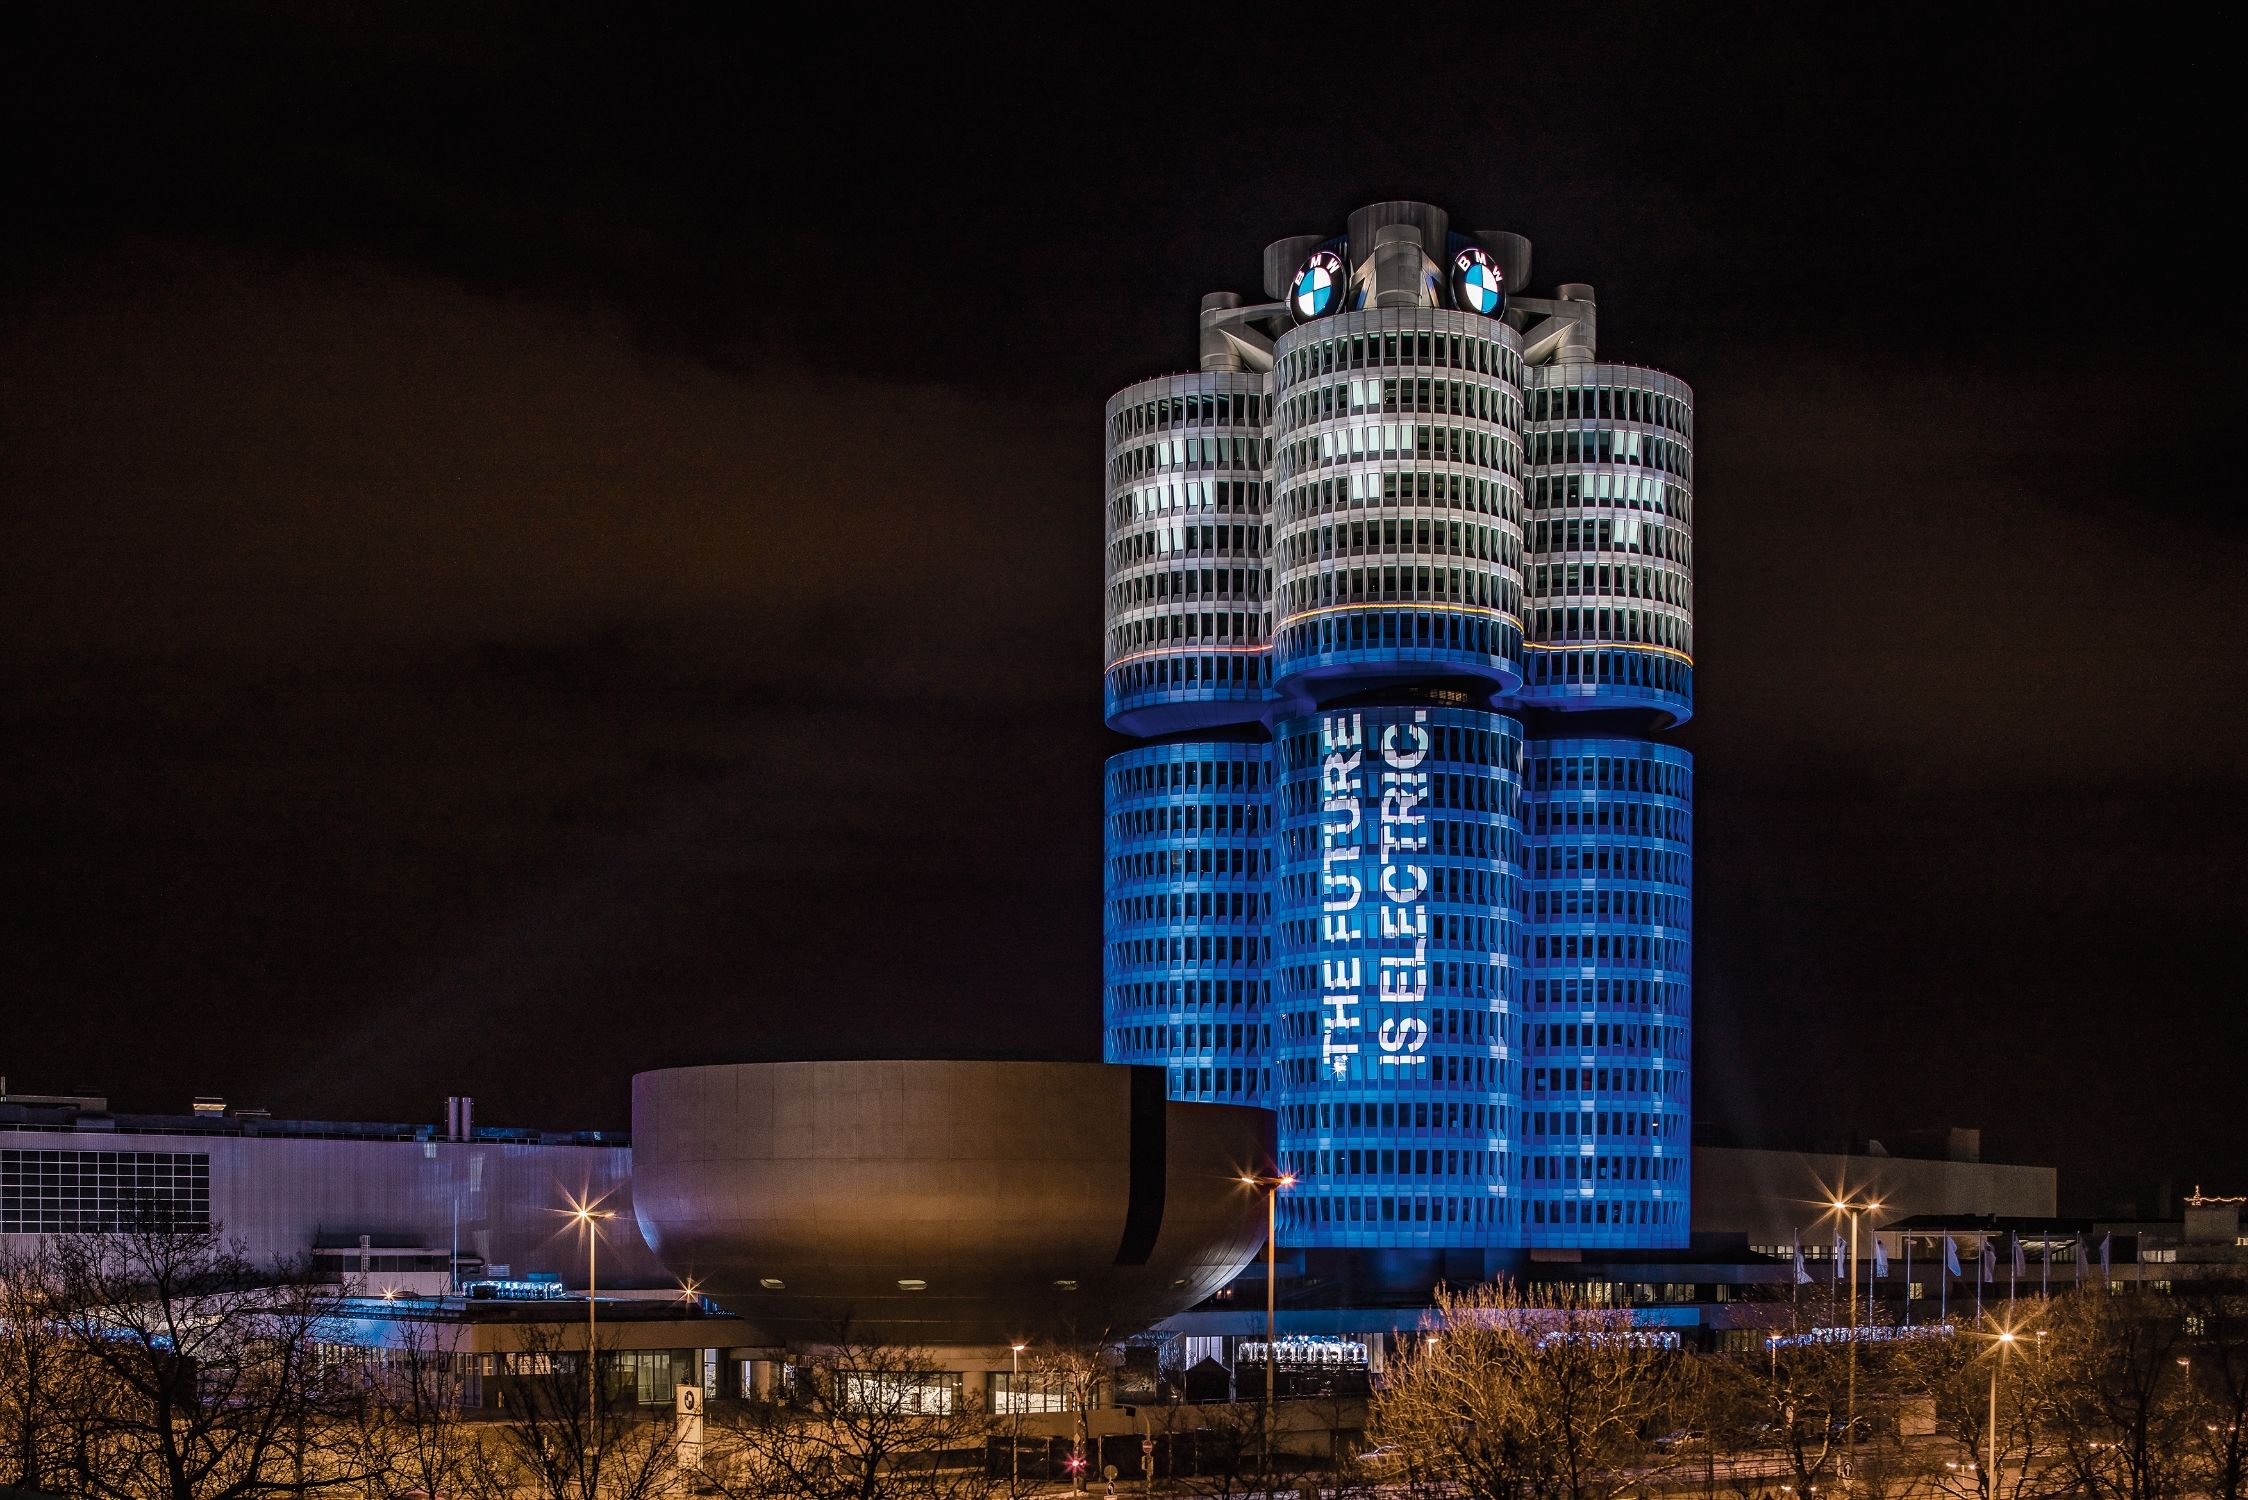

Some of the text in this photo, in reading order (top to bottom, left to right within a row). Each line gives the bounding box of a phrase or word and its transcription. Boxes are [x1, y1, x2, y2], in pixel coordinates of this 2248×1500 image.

[1293, 253, 1341, 287] BMW
[1457, 251, 1504, 283] BMW
[1322, 713, 1362, 1065] THE FUTURE
[1379, 710, 1429, 1065] IS ELECTRIC.
